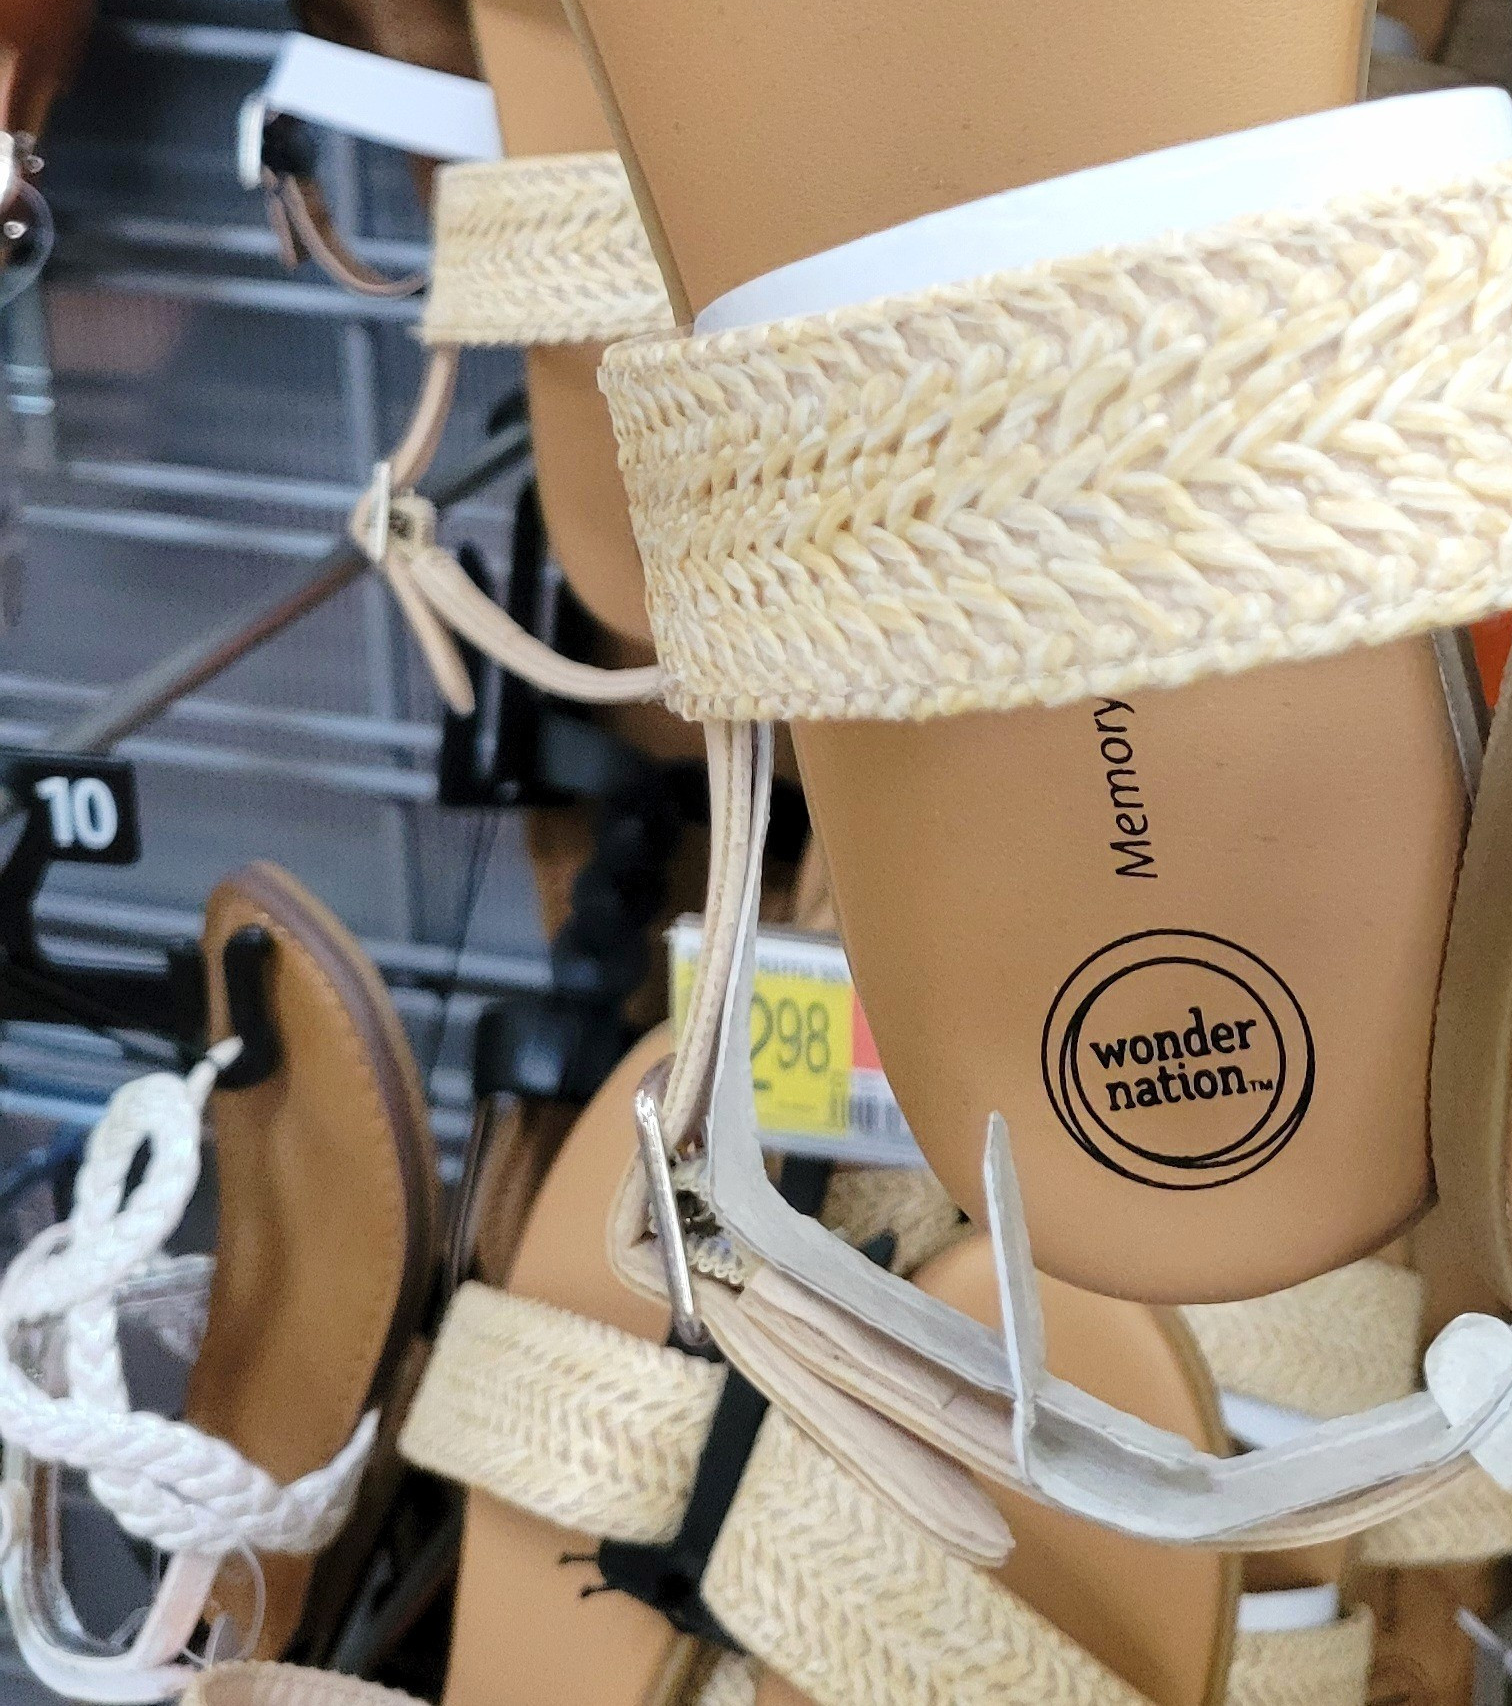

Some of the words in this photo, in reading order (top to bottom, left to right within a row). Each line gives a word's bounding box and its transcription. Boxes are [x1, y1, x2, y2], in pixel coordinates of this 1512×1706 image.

[35, 775, 119, 850] 10
[1094, 696, 1158, 879] Memory
[1089, 1007, 1256, 1070] wonder
